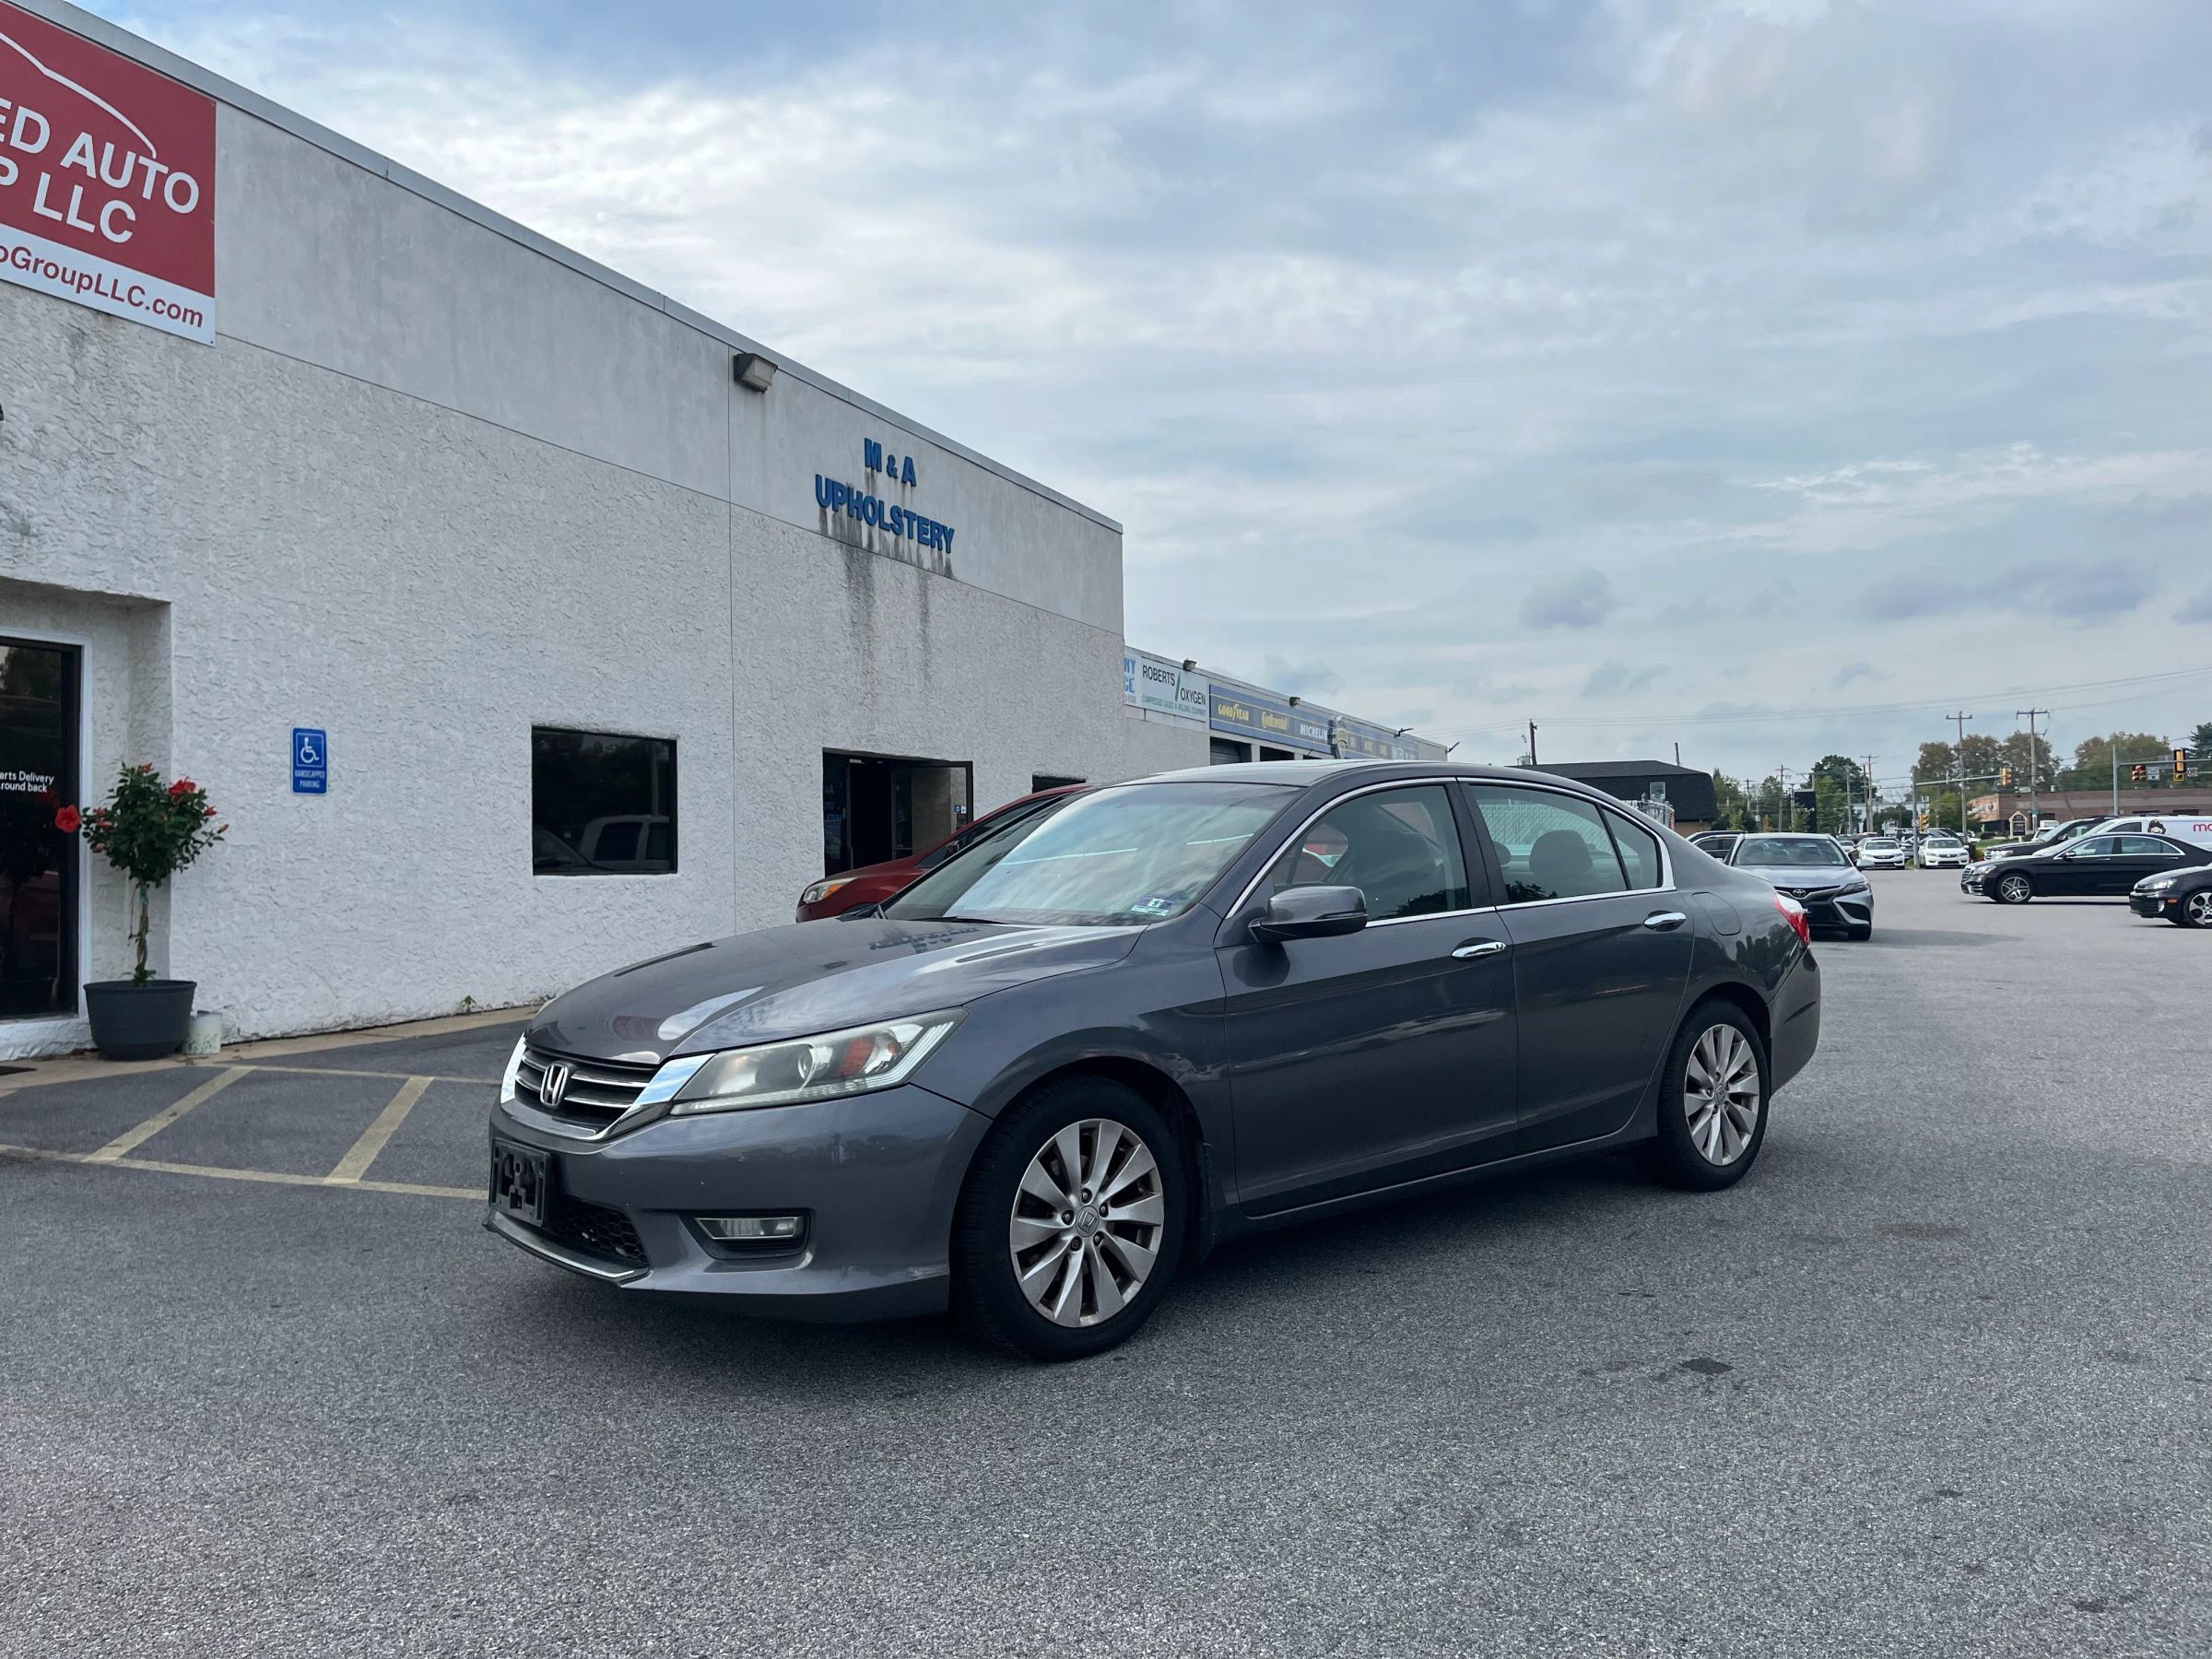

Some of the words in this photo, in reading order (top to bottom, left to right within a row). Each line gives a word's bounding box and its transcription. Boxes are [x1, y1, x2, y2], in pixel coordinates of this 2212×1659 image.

[60, 132, 200, 214] AUTO
[33, 171, 136, 243] LLC
[864, 438, 882, 473] M
[887, 454, 899, 479] &
[901, 456, 917, 488] A
[815, 474, 955, 554] UPHOLSTERY
[1142, 664, 1175, 687] ROBERTS
[1180, 687, 1206, 707] OXYGEN
[1300, 723, 1328, 741] MICHELIN
[18, 771, 54, 785] Delivery
[28, 782, 47, 793] back
